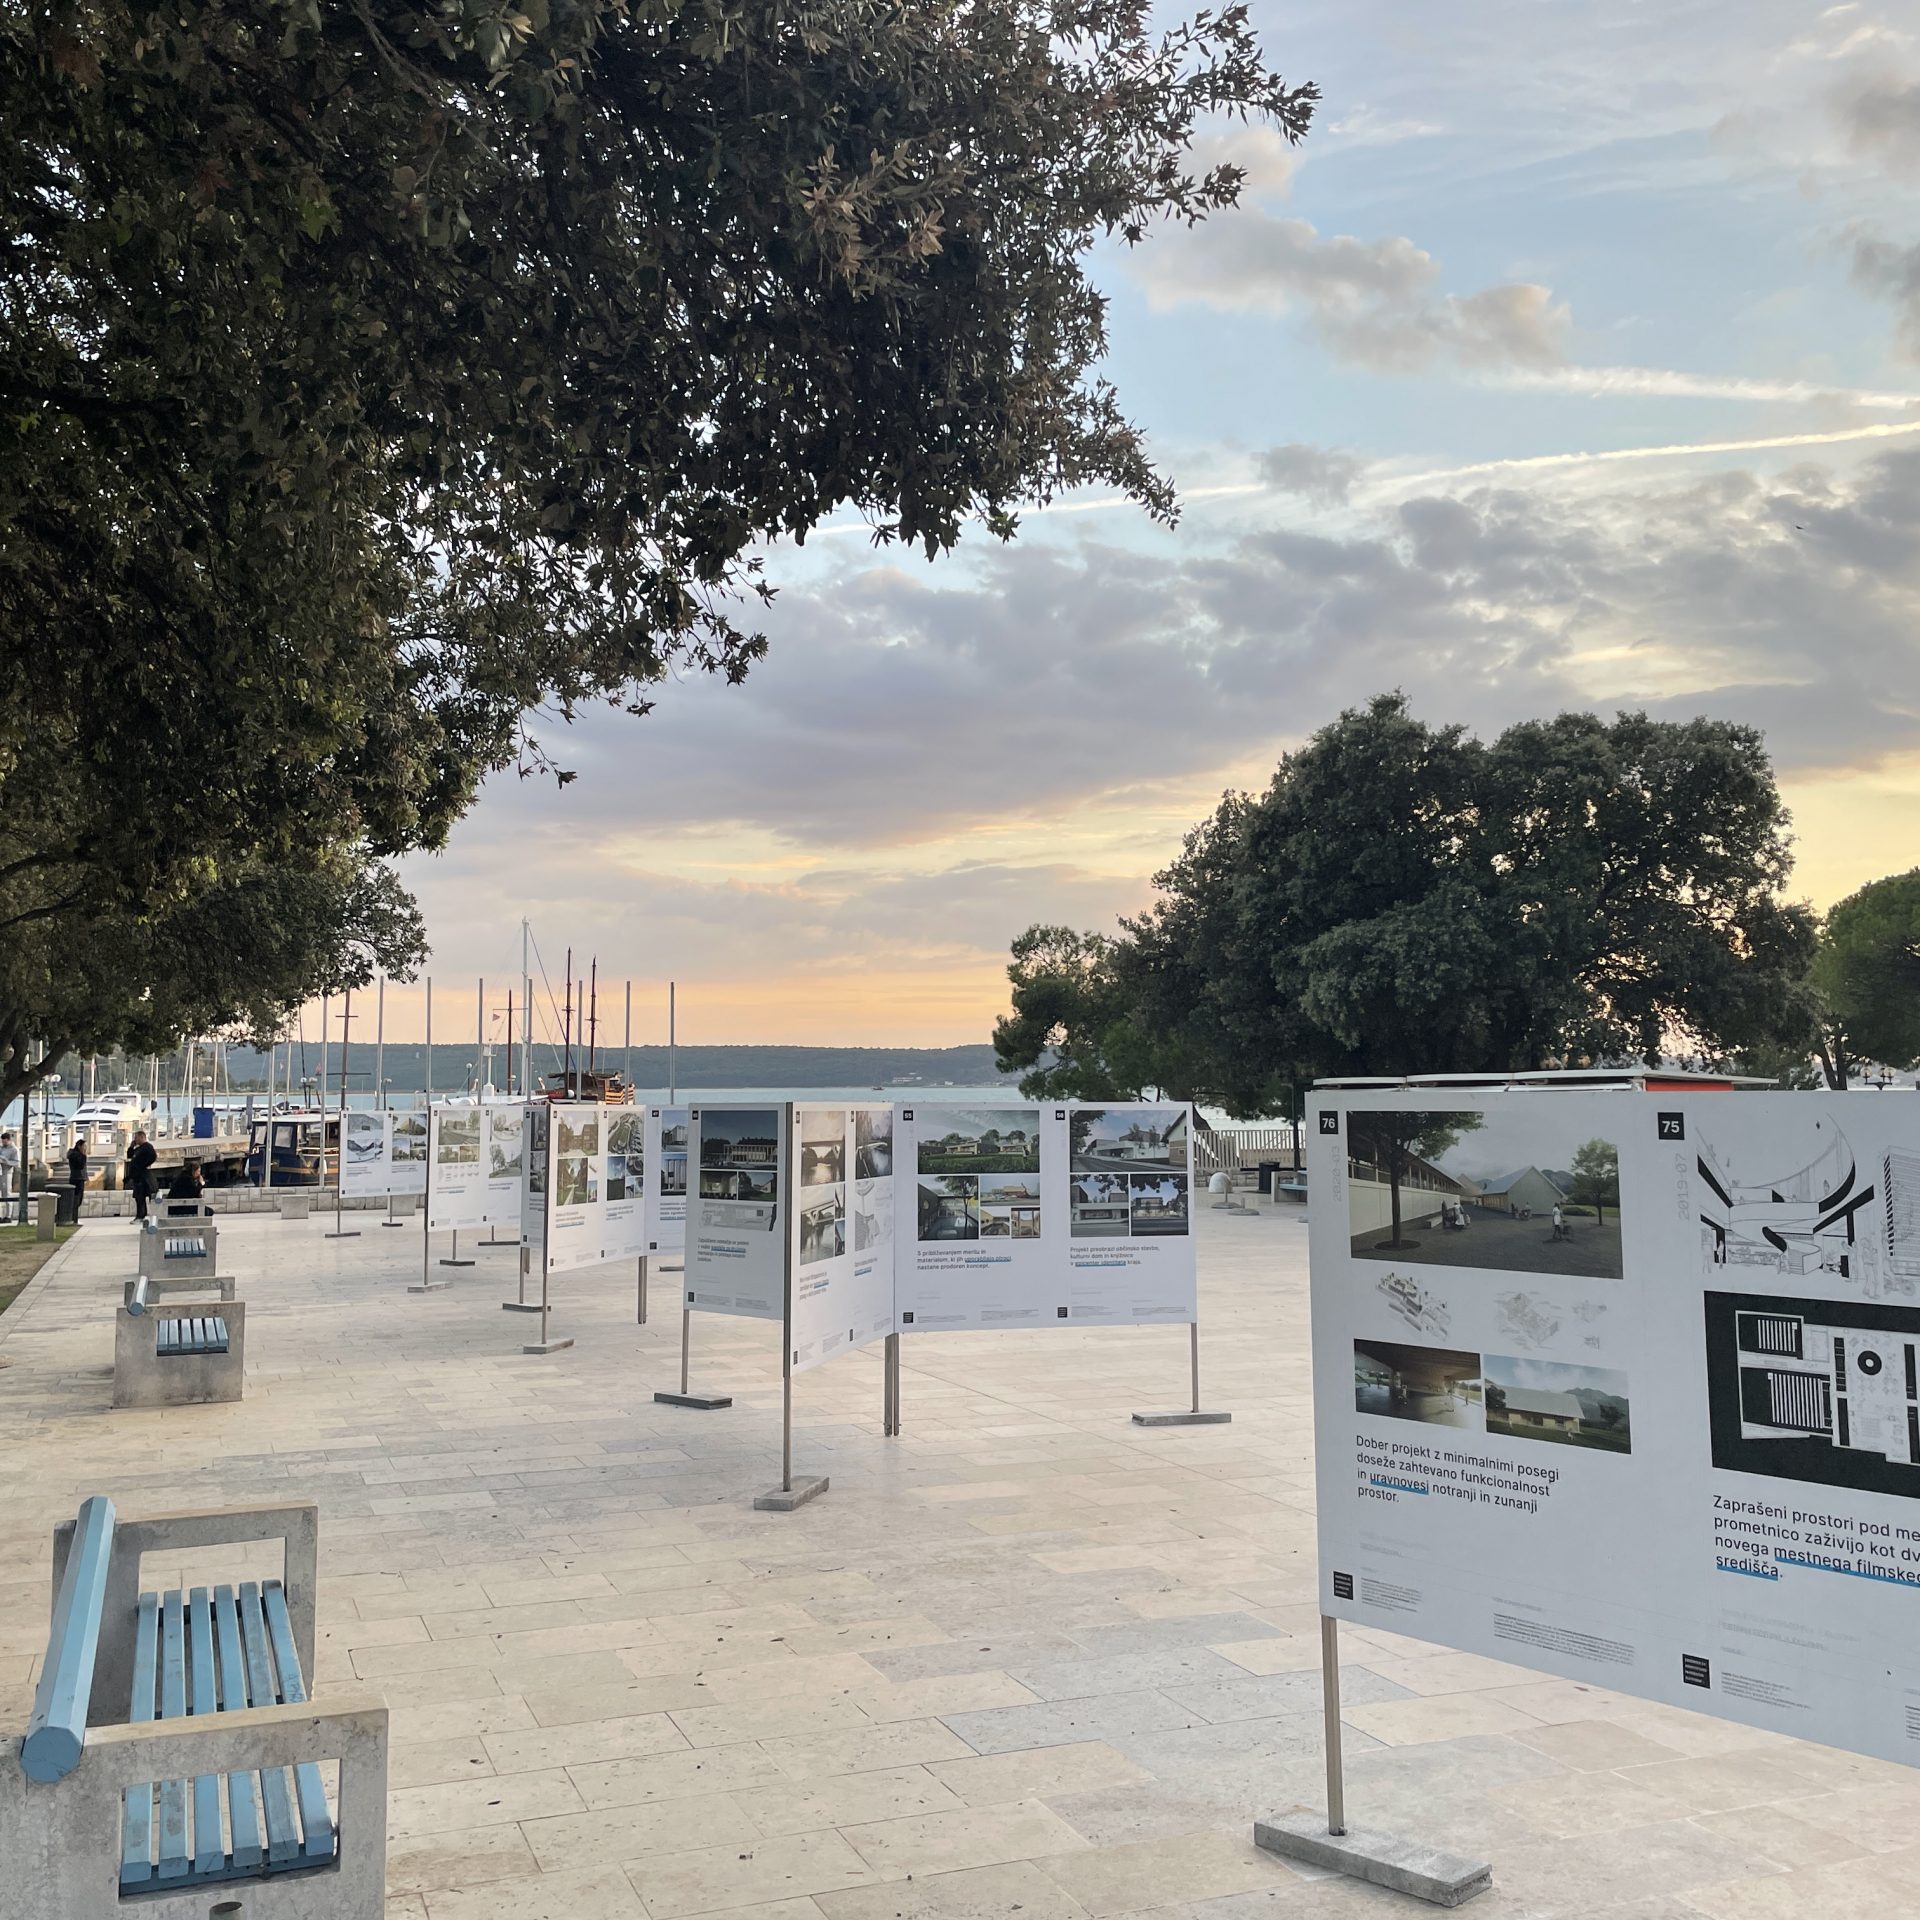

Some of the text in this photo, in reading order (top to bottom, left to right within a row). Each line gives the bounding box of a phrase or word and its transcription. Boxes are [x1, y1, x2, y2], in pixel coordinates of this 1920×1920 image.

[1322, 1117, 1336, 1129] 76
[1661, 1120, 1680, 1134] 75
[1356, 1435, 1559, 1484] Dober projekt z minimalnimi posegi
[1356, 1452, 1550, 1497] doseže zahtevano funkcionalnost
[1357, 1468, 1367, 1479] in
[1432, 1484, 1476, 1503] notranji
[1480, 1490, 1490, 1503] in
[1494, 1495, 1538, 1514] zunanji
[1358, 1486, 1400, 1503] prostor.
[1713, 1494, 1787, 1519] Zaprašeni
[1792, 1511, 1854, 1531] prostori
[1859, 1522, 1890, 1537] pod
[1714, 1517, 1800, 1541] prometnico
[1804, 1532, 1864, 1554] zaživijo
[1870, 1541, 1896, 1558] kot
[1715, 1536, 1769, 1557] novega
[1774, 1547, 1851, 1572] mestnega
[1716, 1555, 1783, 1579] središča.
